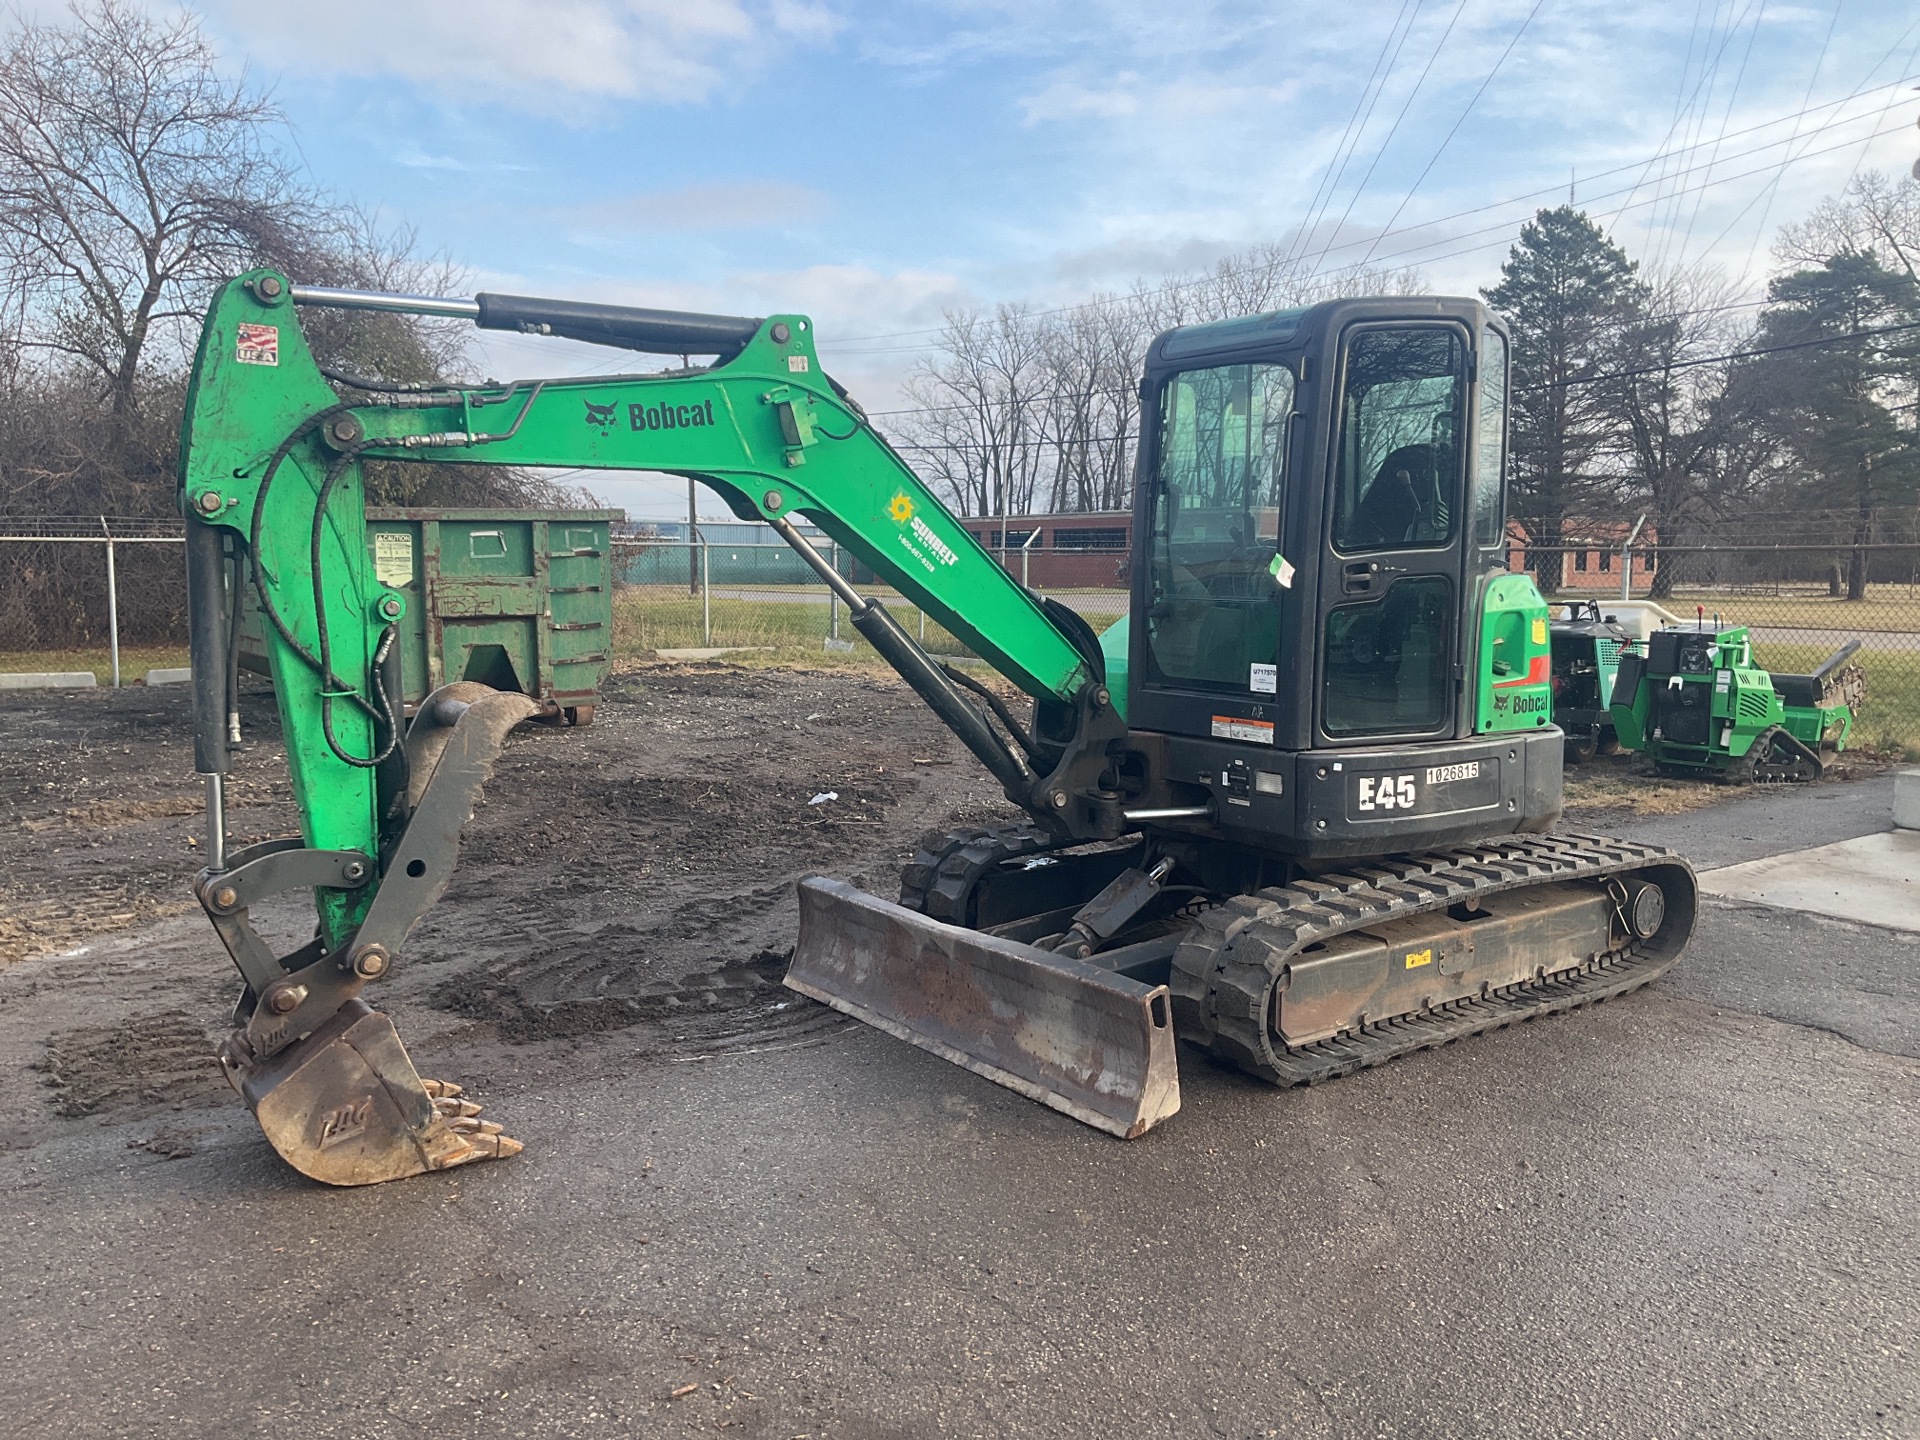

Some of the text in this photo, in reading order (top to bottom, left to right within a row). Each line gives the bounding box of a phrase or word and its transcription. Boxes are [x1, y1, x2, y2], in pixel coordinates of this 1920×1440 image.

[239, 350, 275, 362] USA
[628, 400, 715, 432] Bobcat
[383, 534, 411, 543] CAUTION
[910, 516, 959, 566] SUNBELT
[913, 531, 946, 565] RENTALS
[1428, 763, 1478, 783] 1026815
[1359, 775, 1416, 811] E45
